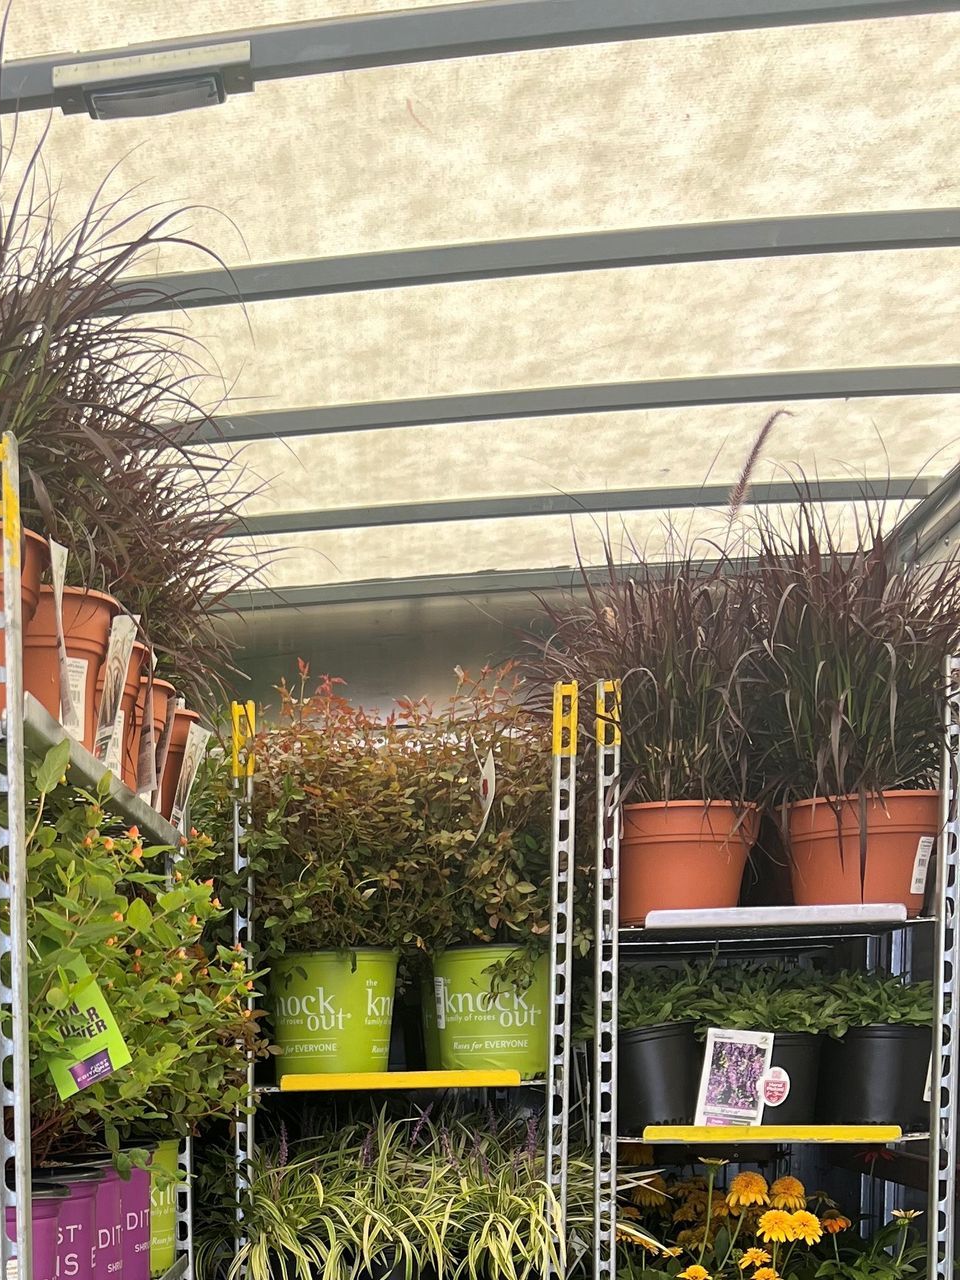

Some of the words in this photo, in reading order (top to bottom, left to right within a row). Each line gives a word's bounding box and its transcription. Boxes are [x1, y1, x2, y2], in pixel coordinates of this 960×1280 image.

[307, 1007, 345, 1031] out
[500, 1004, 536, 1028] out
[295, 1043, 337, 1053] EVERYONE
[484, 1039, 528, 1049] EVERYONE
